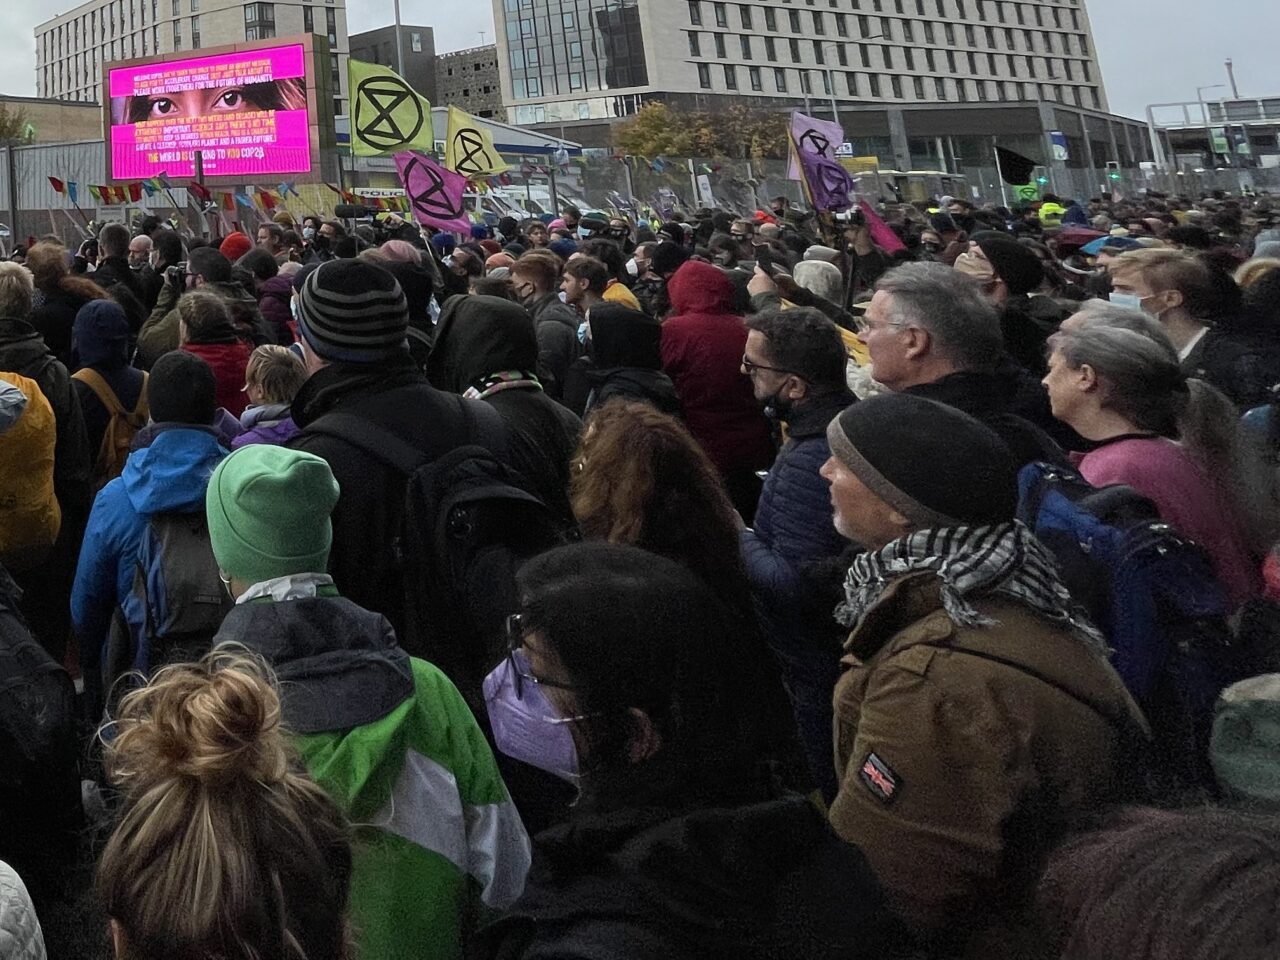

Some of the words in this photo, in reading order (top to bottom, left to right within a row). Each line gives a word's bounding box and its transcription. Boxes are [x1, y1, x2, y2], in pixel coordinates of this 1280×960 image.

[133, 87, 151, 97] PLEASE
[152, 86, 165, 94] WORK
[195, 81, 205, 90] FOR
[206, 80, 215, 89] THE
[216, 77, 236, 87] FUTURE
[237, 77, 243, 85] OF
[201, 139, 218, 147] PLANET
[148, 153, 158, 163] THE
[160, 152, 180, 162] WORLD
[182, 151, 188, 161] IS
[217, 149, 225, 159] TO
